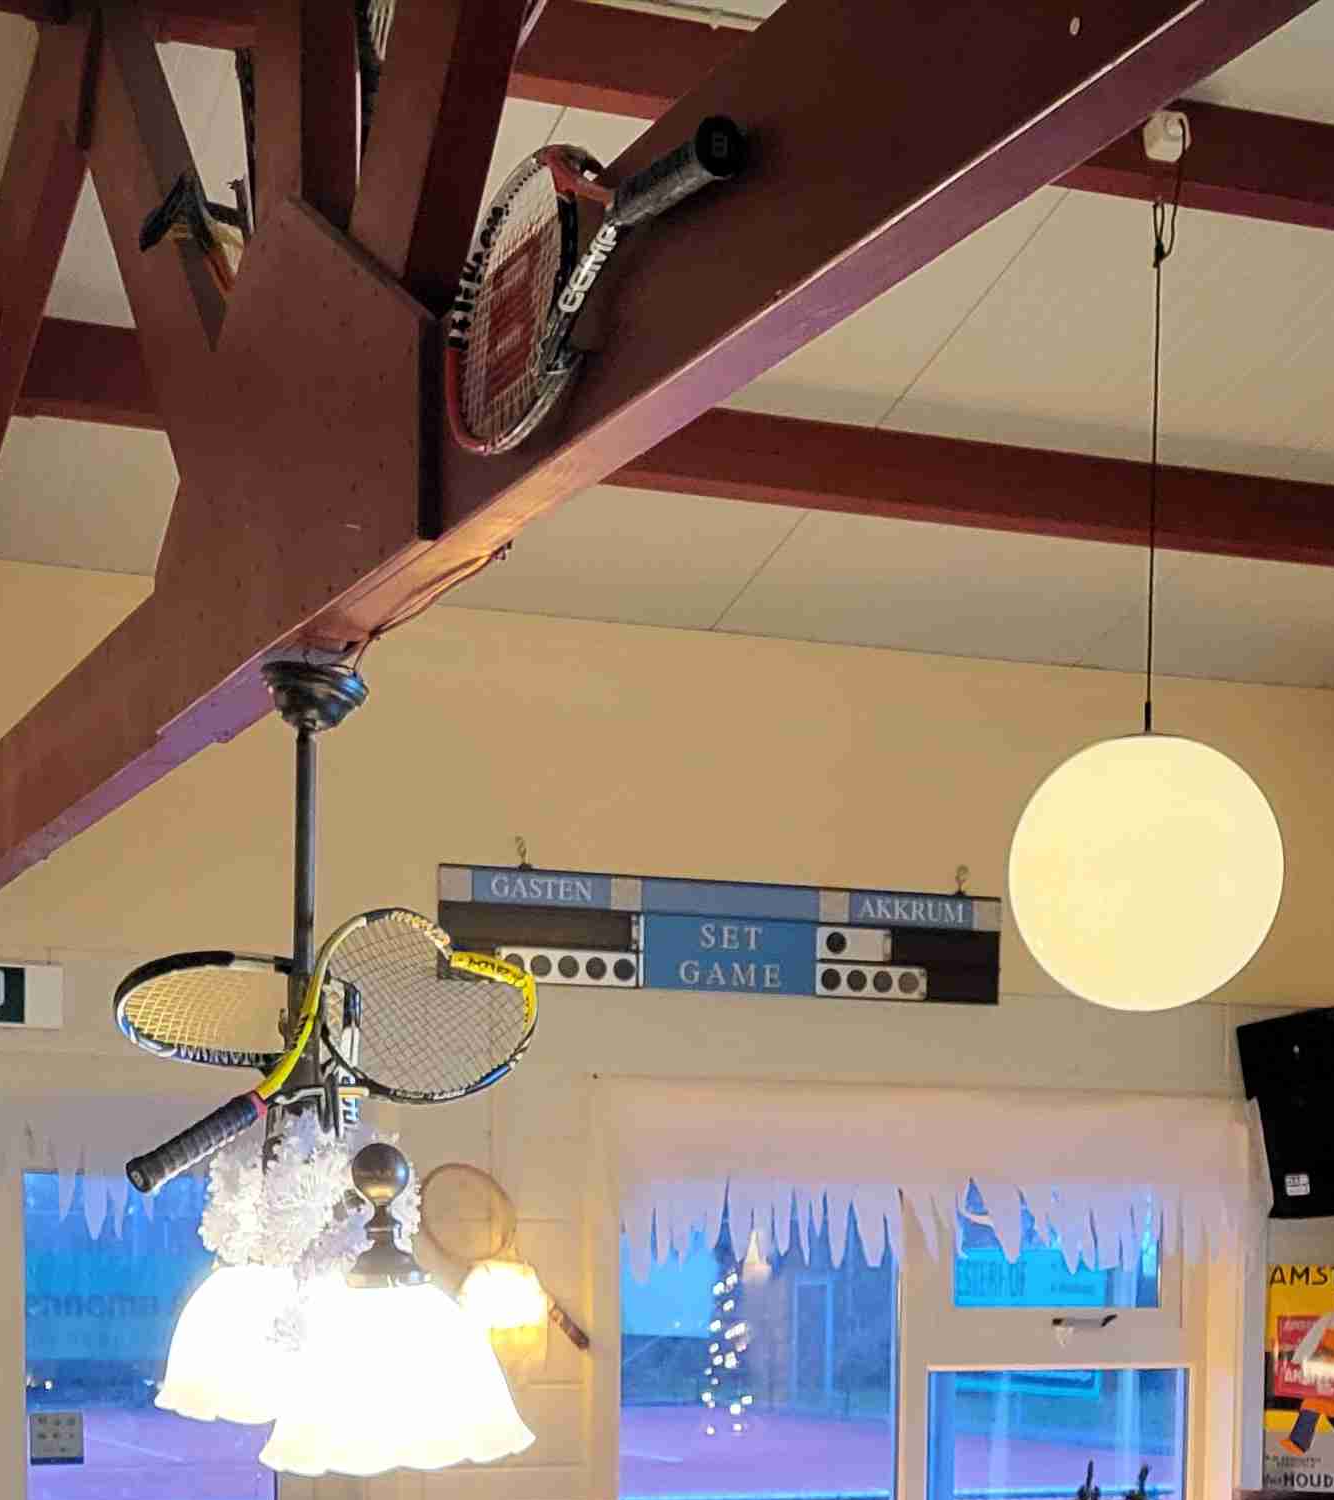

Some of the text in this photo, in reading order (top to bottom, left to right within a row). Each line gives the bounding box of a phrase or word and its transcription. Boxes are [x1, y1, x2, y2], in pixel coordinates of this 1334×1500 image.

[489, 874, 595, 902] GASTEN
[857, 897, 965, 924] AKKRUM
[699, 924, 764, 952] SET
[679, 961, 783, 988] GAME
